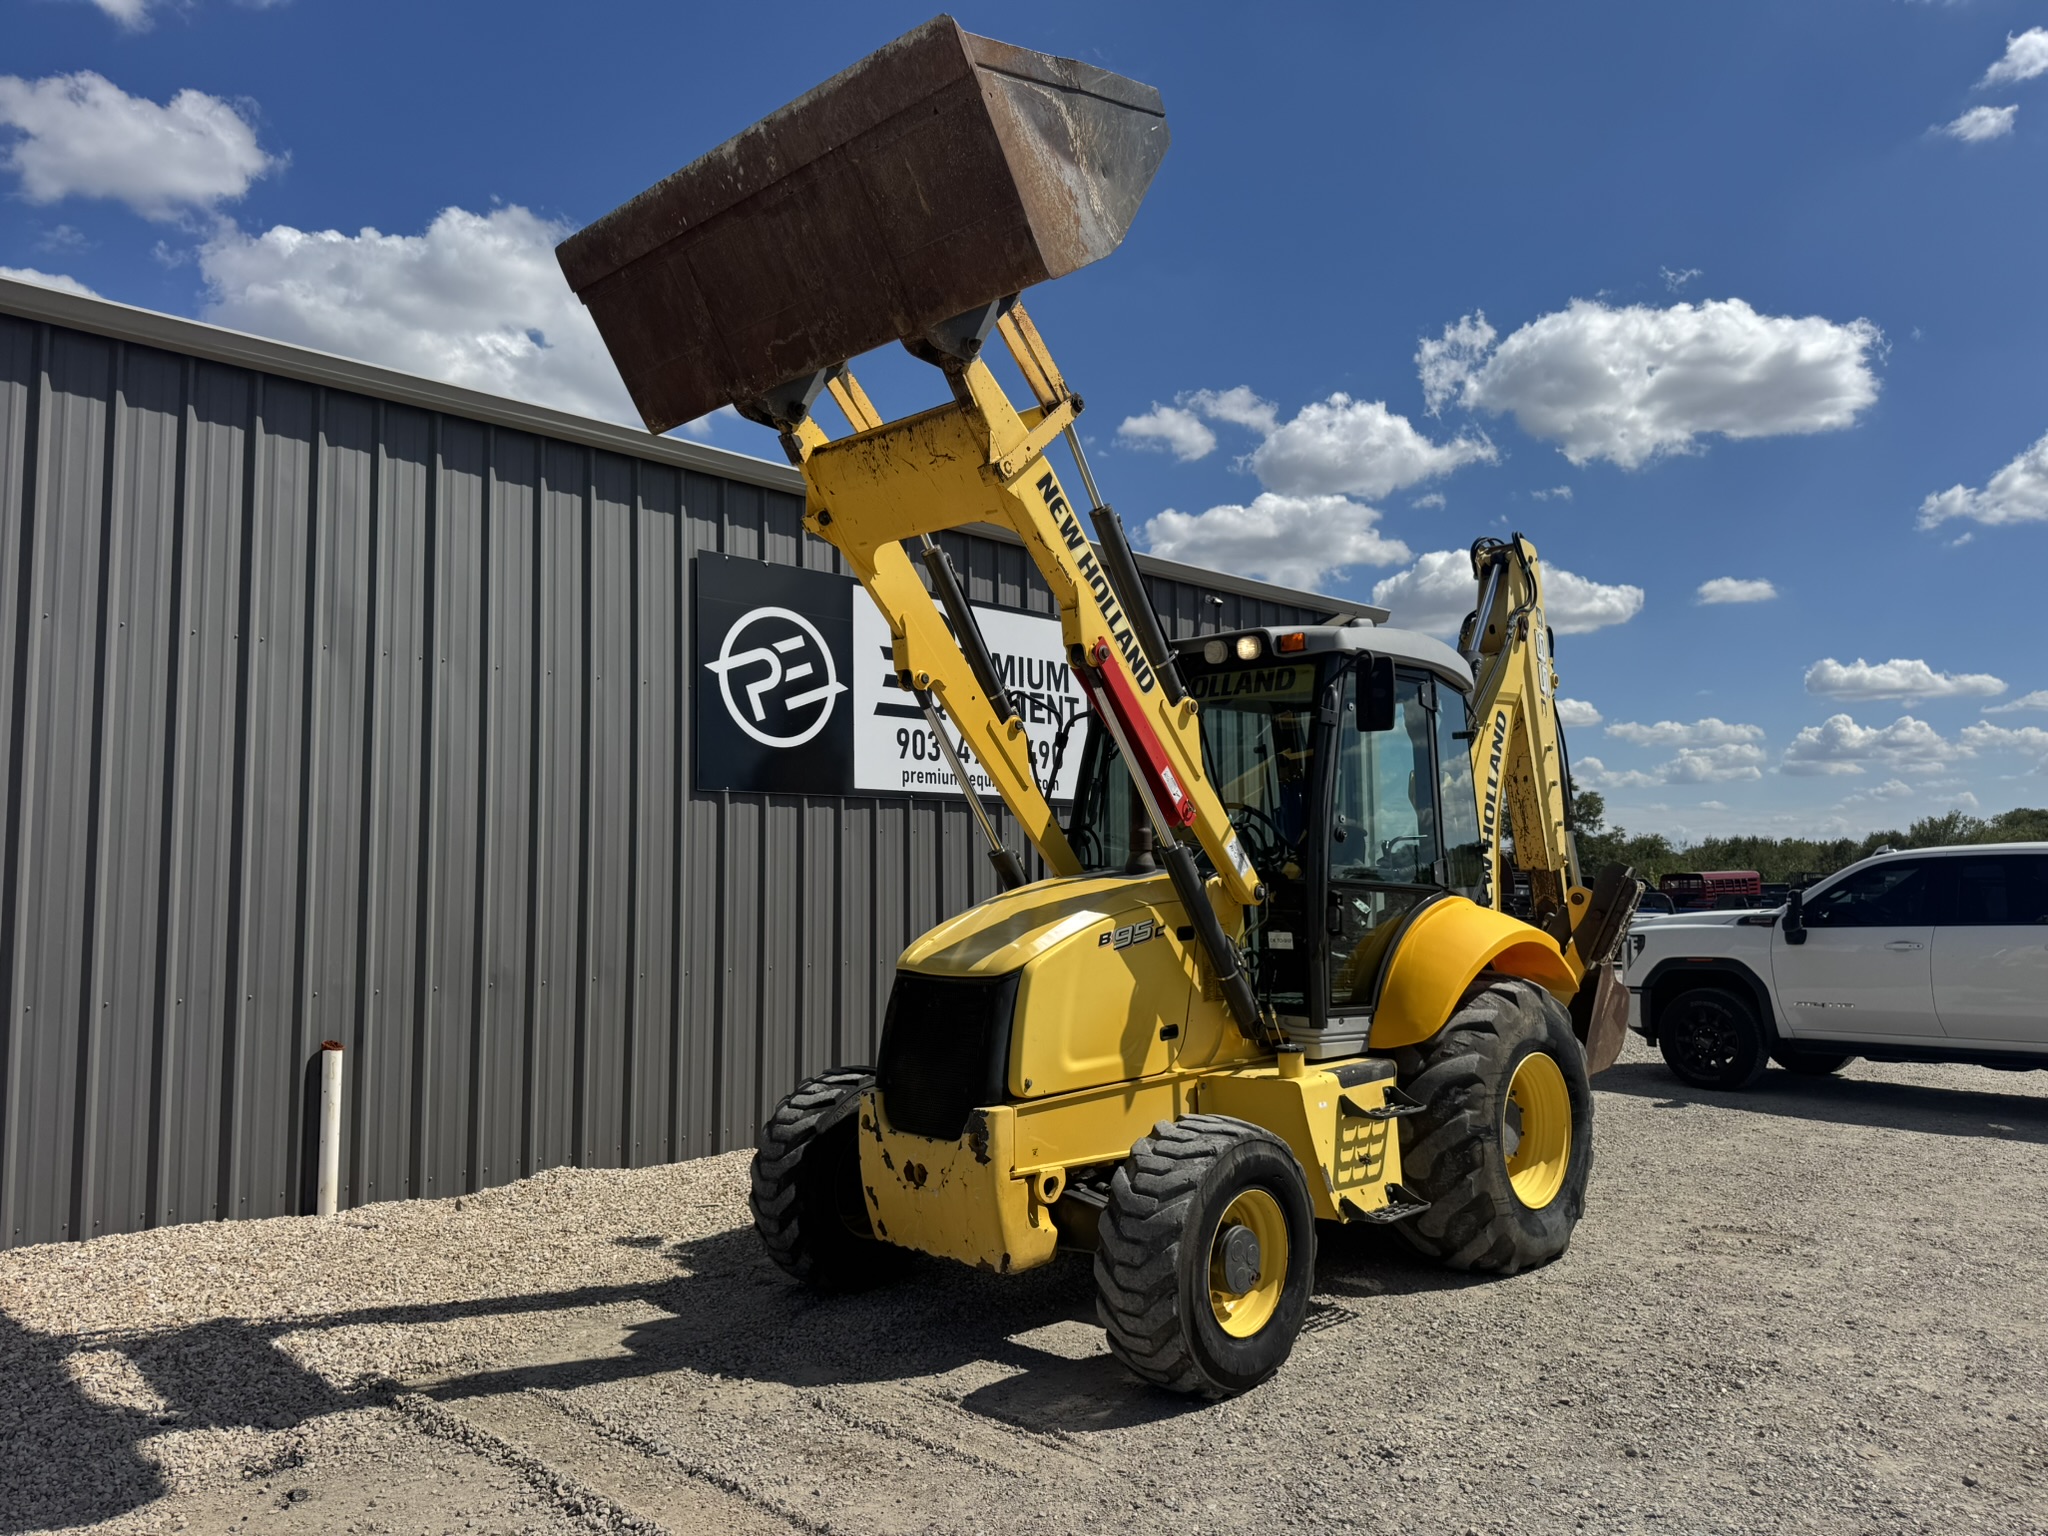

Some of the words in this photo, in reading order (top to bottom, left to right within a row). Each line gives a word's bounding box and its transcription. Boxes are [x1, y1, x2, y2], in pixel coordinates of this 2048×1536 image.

[1036, 472, 1085, 551] NEW
[1077, 552, 1156, 694] HOLLAND
[992, 653, 1070, 694] MIUM
[1194, 667, 1296, 698] OLLAND
[1482, 711, 1507, 853] HOLLAND
